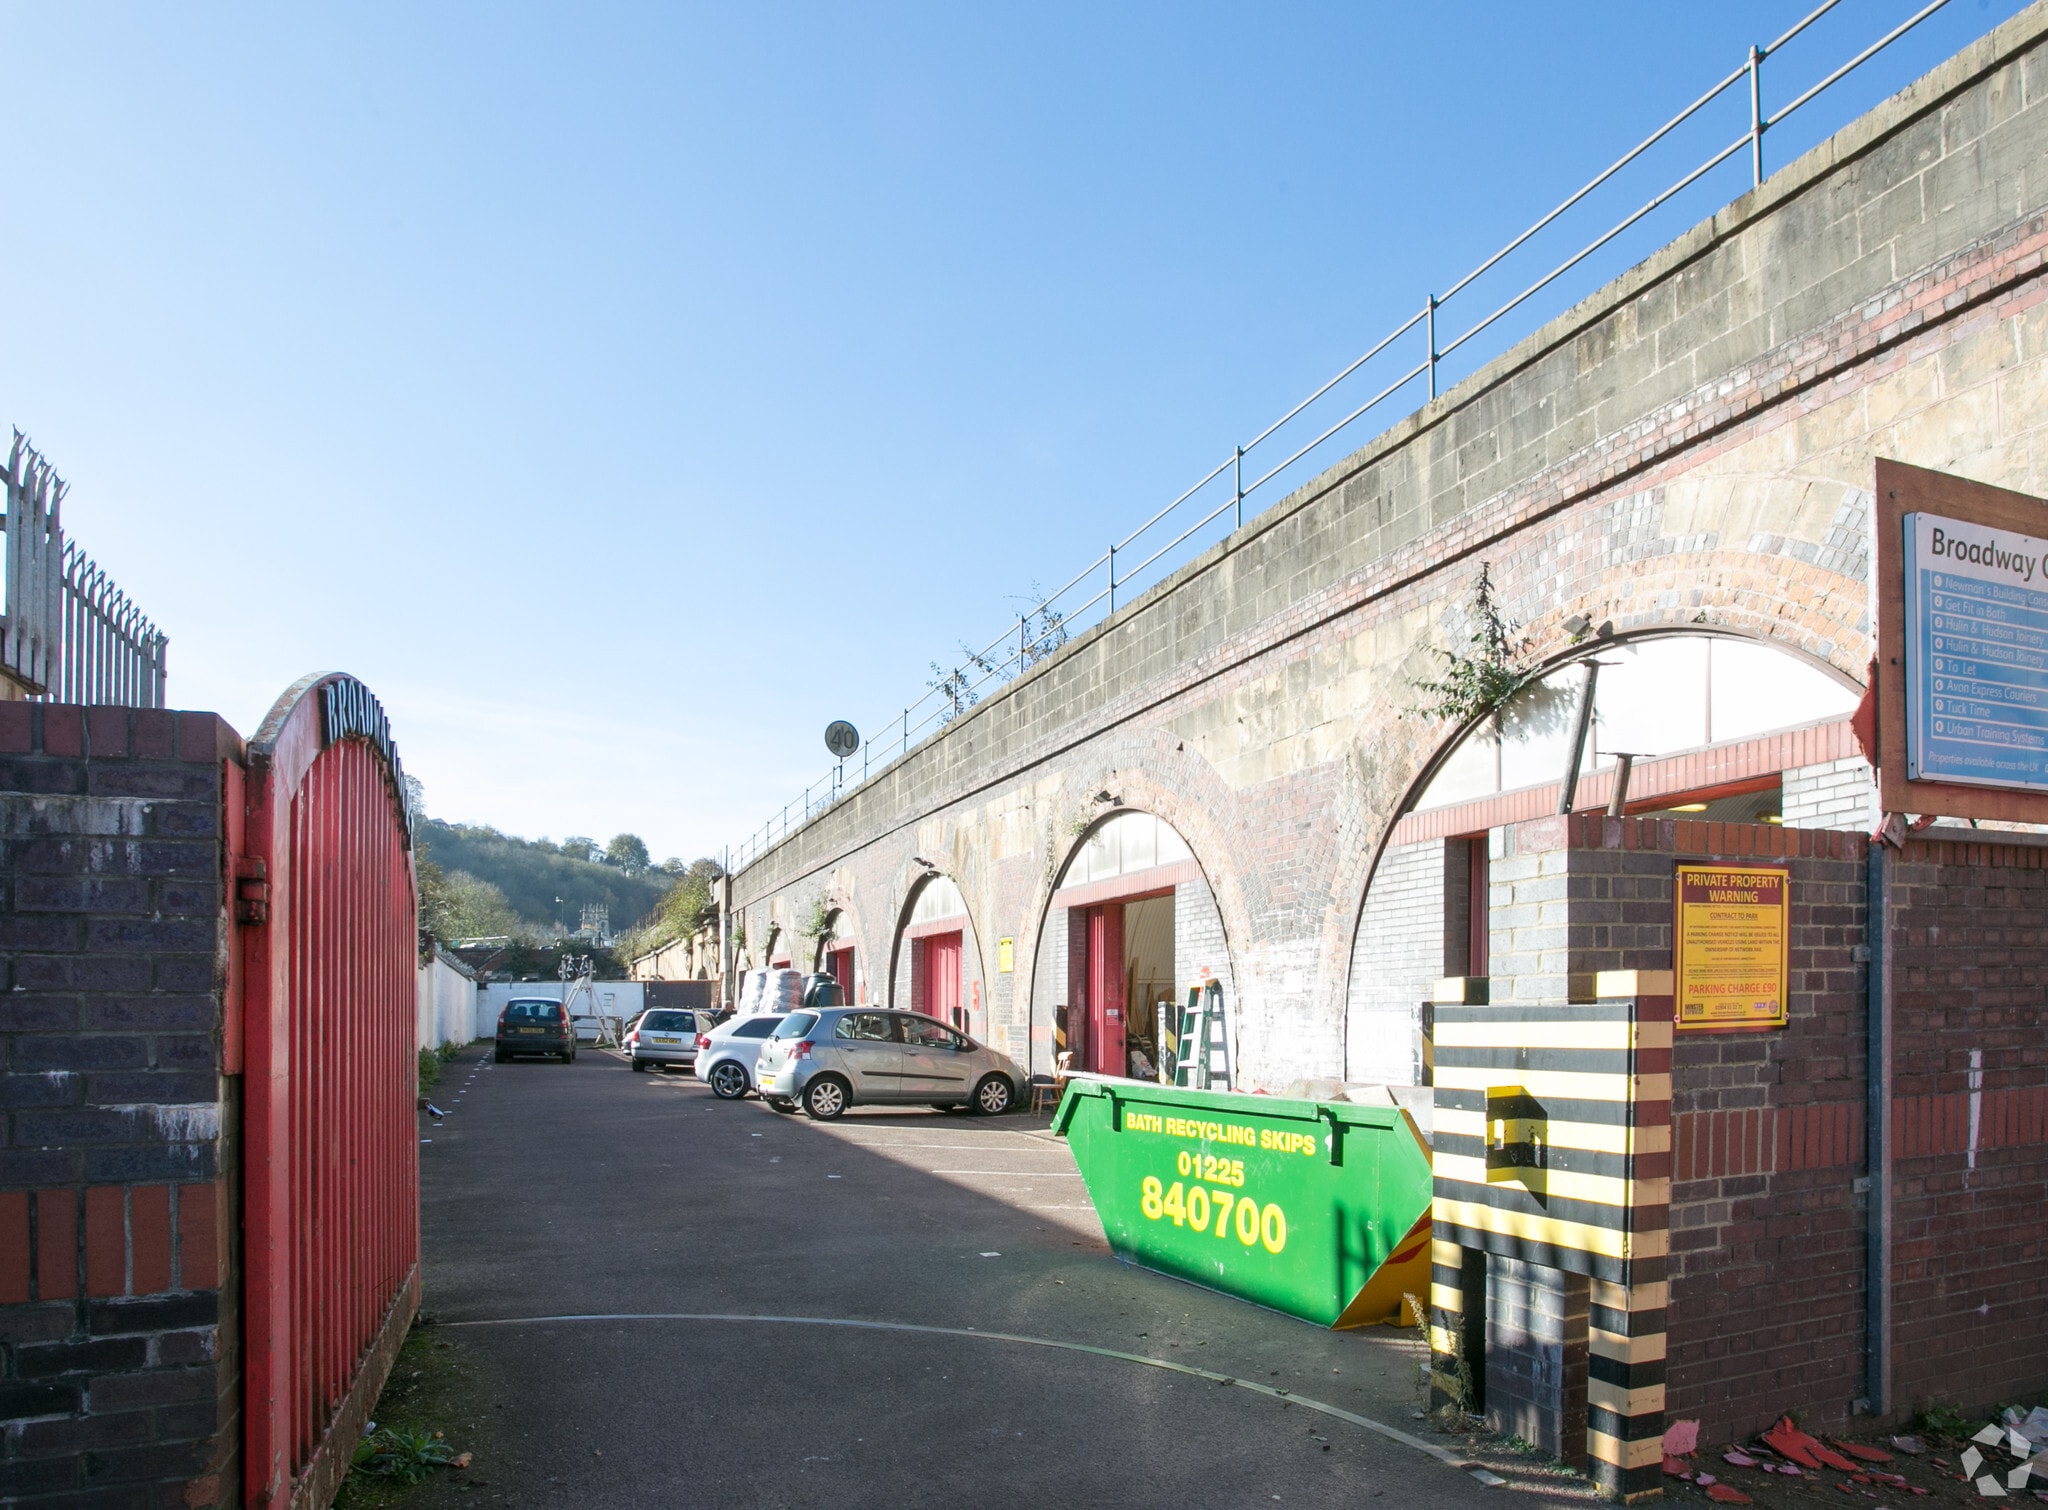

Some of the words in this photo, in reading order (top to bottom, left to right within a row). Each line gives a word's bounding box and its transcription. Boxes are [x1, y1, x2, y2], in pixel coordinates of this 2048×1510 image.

[1931, 528, 2037, 582] Broadway
[1993, 586, 2027, 605] Building
[1945, 599, 1961, 612] Get
[1963, 602, 1974, 614] Fit
[1976, 606, 1984, 616] in
[1986, 606, 2006, 620] Bath
[1946, 618, 1969, 632] Hulin
[1970, 622, 1978, 634] &
[1982, 624, 2014, 640] Hudson
[2015, 630, 2044, 648] Joinery
[1946, 639, 1969, 653] Hulin
[1970, 643, 1978, 655] &
[1982, 645, 2014, 660] Hudson
[2015, 650, 2045, 668] Joinery
[1947, 659, 1959, 673] To
[1962, 663, 1976, 676] Let
[1947, 680, 1970, 694] Avon
[1971, 683, 2003, 698] Express
[2004, 687, 2037, 703] Couriers
[1947, 700, 1967, 714] Tuck
[1969, 703, 1991, 718] Time
[830, 728, 854, 749] 40
[1947, 721, 1974, 736] Urban
[1976, 726, 2010, 744] Training
[2012, 730, 2045, 745] Systems
[1929, 751, 1963, 765] Properties
[1964, 757, 1995, 768] available
[1996, 761, 2017, 770] across
[2017, 761, 2028, 771] the
[2029, 763, 2039, 772] UK
[1686, 873, 1728, 887] PRIVATE
[1730, 875, 1780, 889] PROPERTY
[1709, 889, 1759, 903] WARNING
[1745, 912, 1758, 920] PARK
[972, 979, 980, 1012] 5
[1688, 984, 1726, 994] PARKING
[1727, 983, 1760, 994] CHARGE
[1762, 982, 1777, 993] £90
[1126, 1111, 1163, 1132] BATH
[1165, 1118, 1257, 1147] RECYCLING
[1260, 1128, 1317, 1157] SKIPS
[1177, 1150, 1245, 1188] 01225
[1140, 1175, 1288, 1255] 840700
